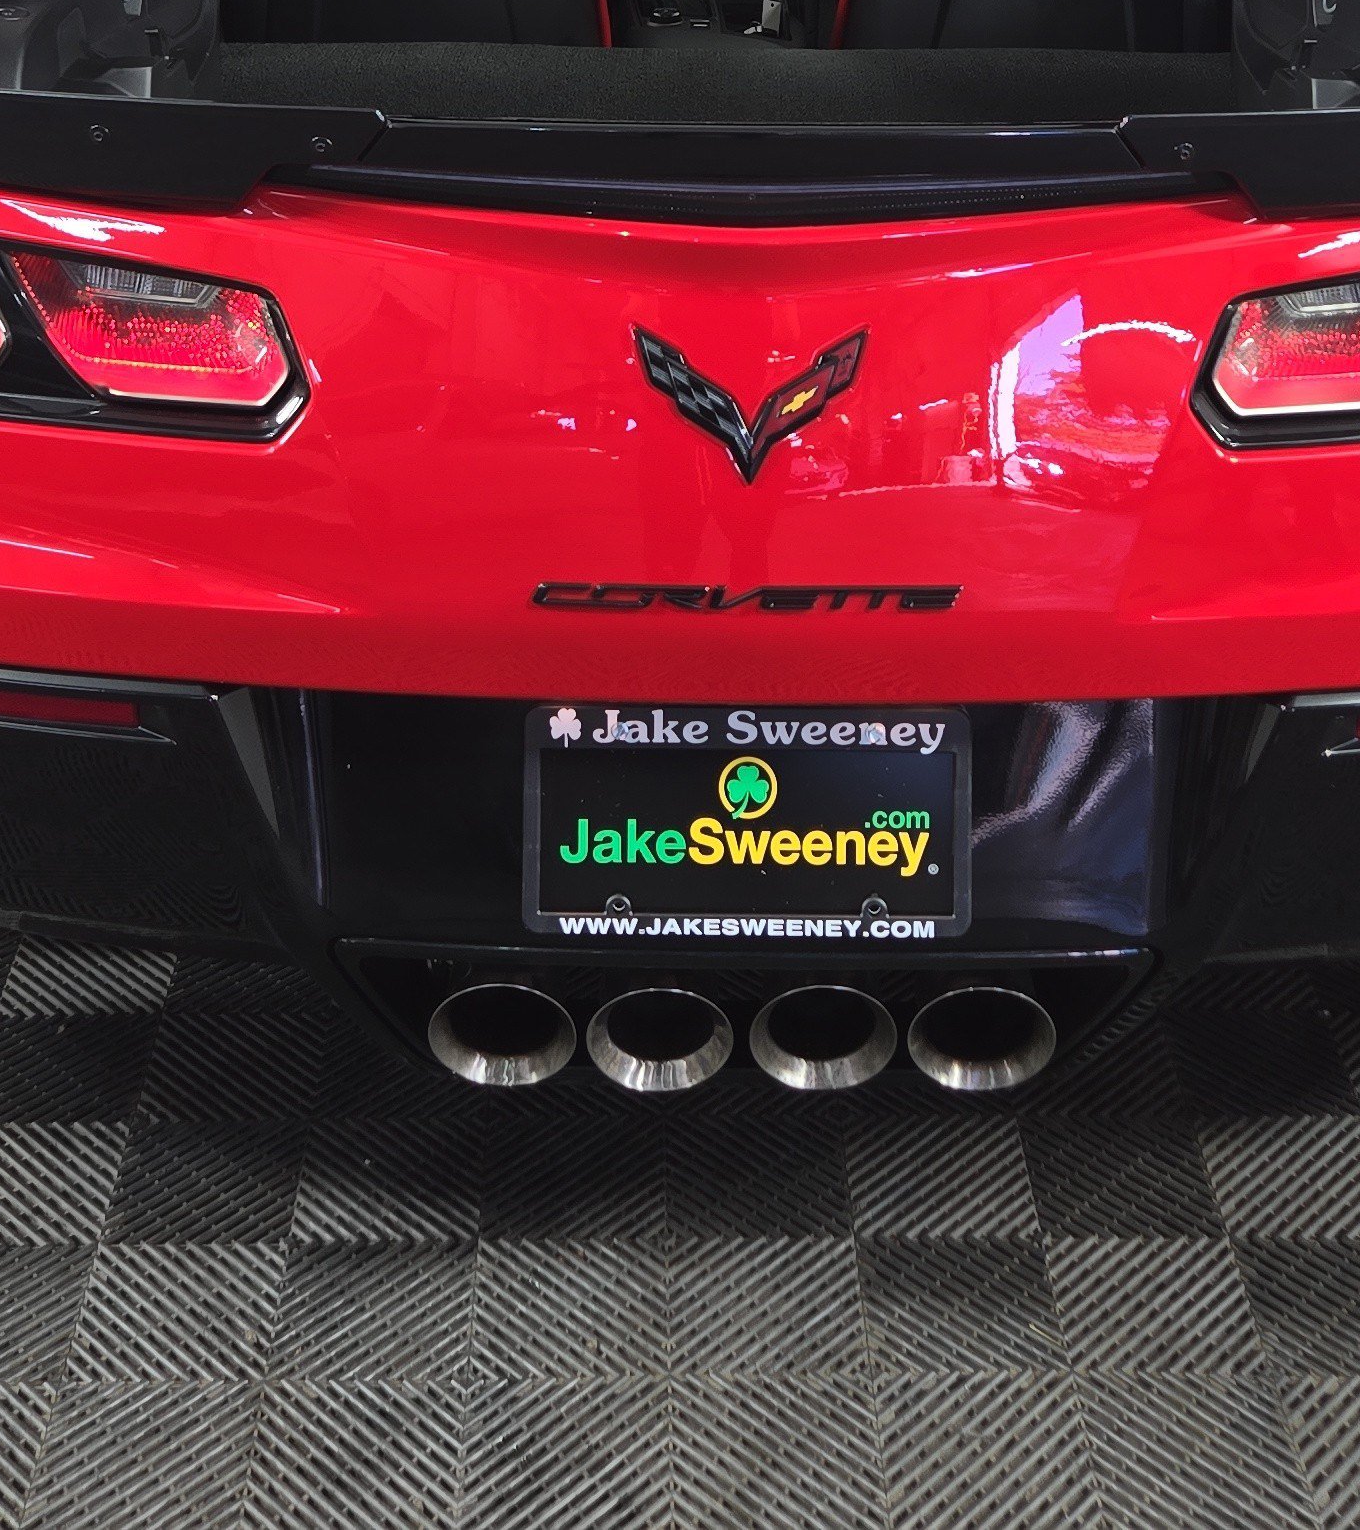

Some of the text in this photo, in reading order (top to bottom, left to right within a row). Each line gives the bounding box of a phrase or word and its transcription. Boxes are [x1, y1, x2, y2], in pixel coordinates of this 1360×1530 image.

[533, 582, 964, 610] CORVETTE
[592, 709, 709, 745] Jake
[865, 810, 929, 829] .com
[559, 917, 934, 938] WWW.JAKESWEENEY.COM
